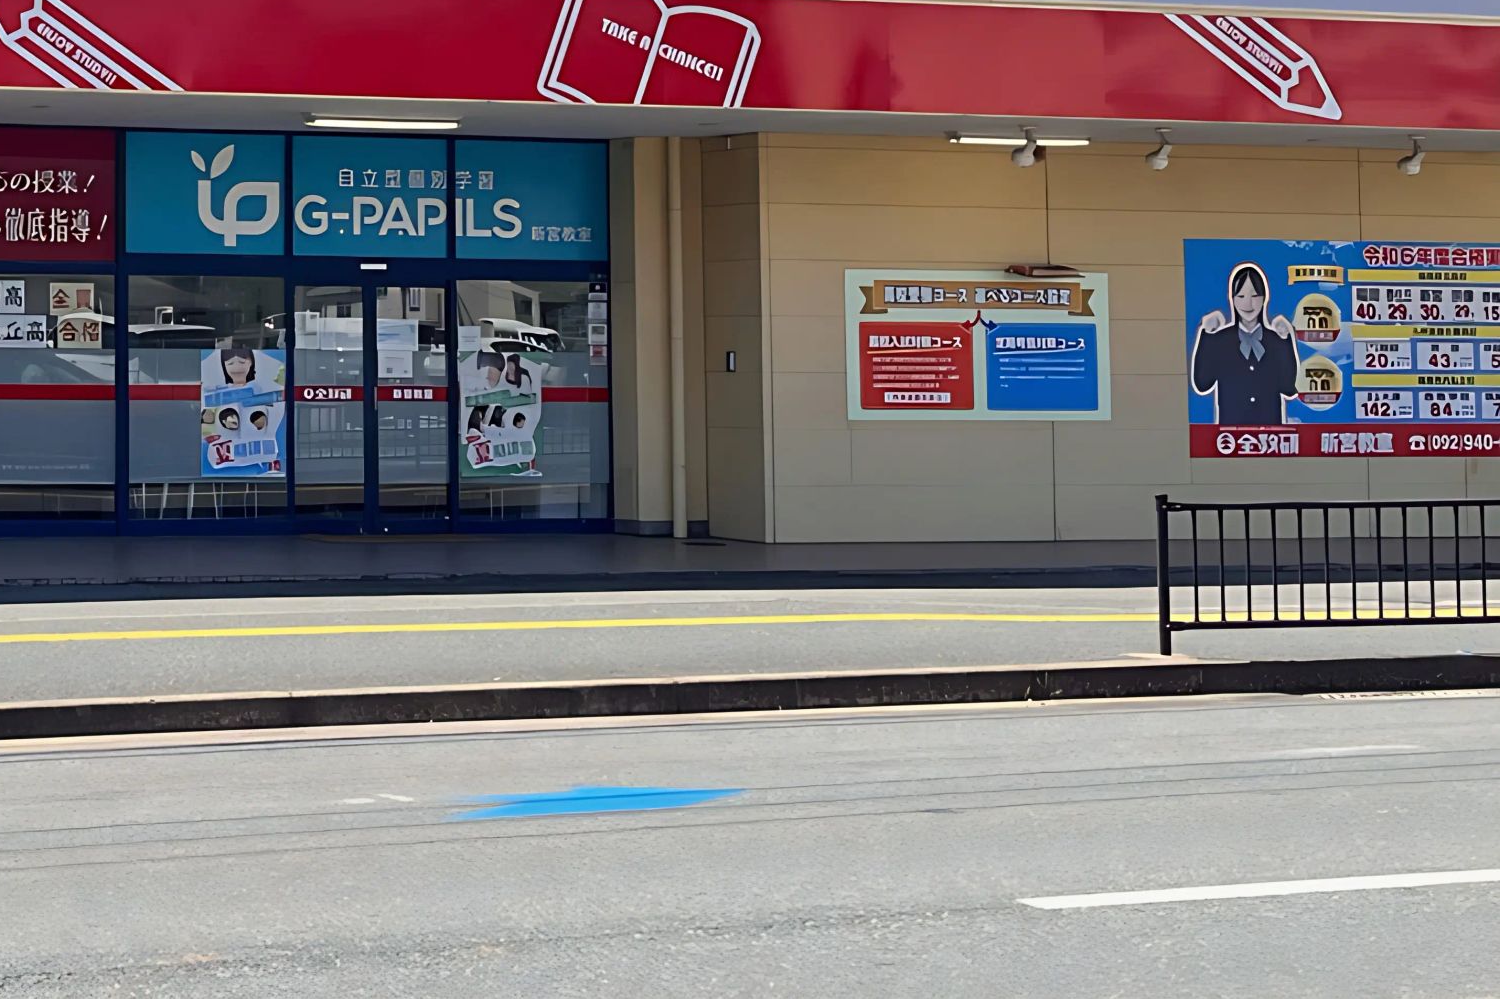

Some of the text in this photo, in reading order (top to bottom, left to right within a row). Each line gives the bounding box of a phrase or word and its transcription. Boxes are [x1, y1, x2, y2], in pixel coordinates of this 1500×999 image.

[602, 18, 638, 45] TAKE
[639, 35, 652, 51] A
[295, 193, 523, 239] G-PAPILS
